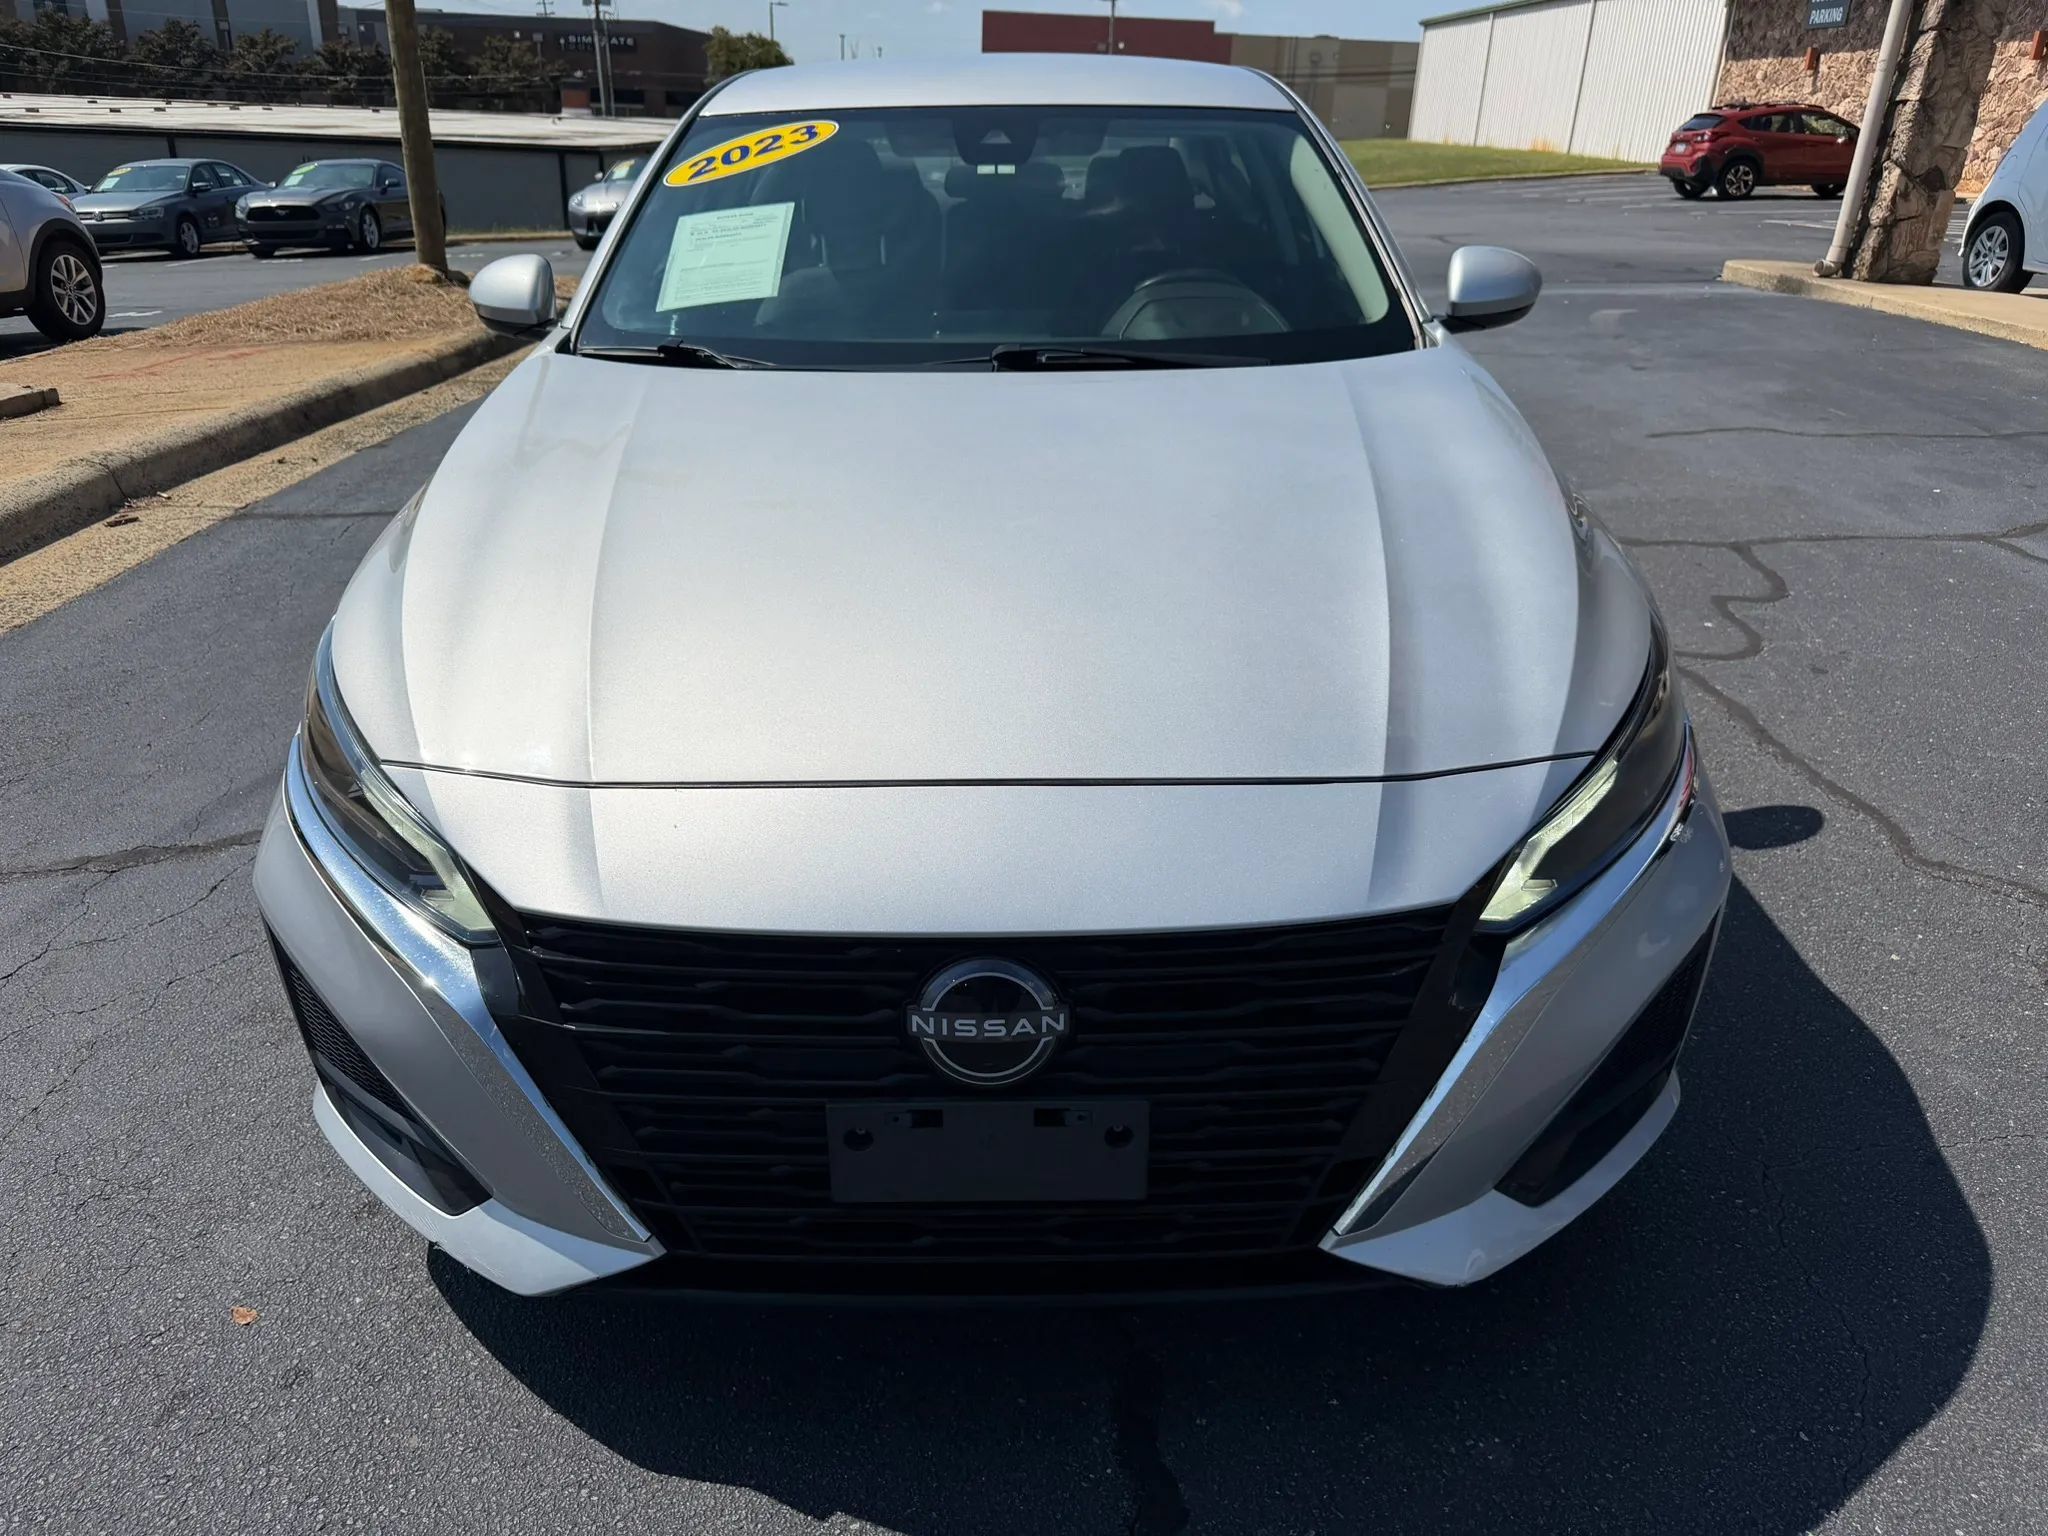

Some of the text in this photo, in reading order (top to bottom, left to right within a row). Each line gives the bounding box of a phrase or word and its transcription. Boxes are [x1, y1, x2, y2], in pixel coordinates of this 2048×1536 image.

[1808, 7, 1844, 25] PARKING
[687, 124, 819, 181] 2023
[911, 1013, 1065, 1037] NISSAN
